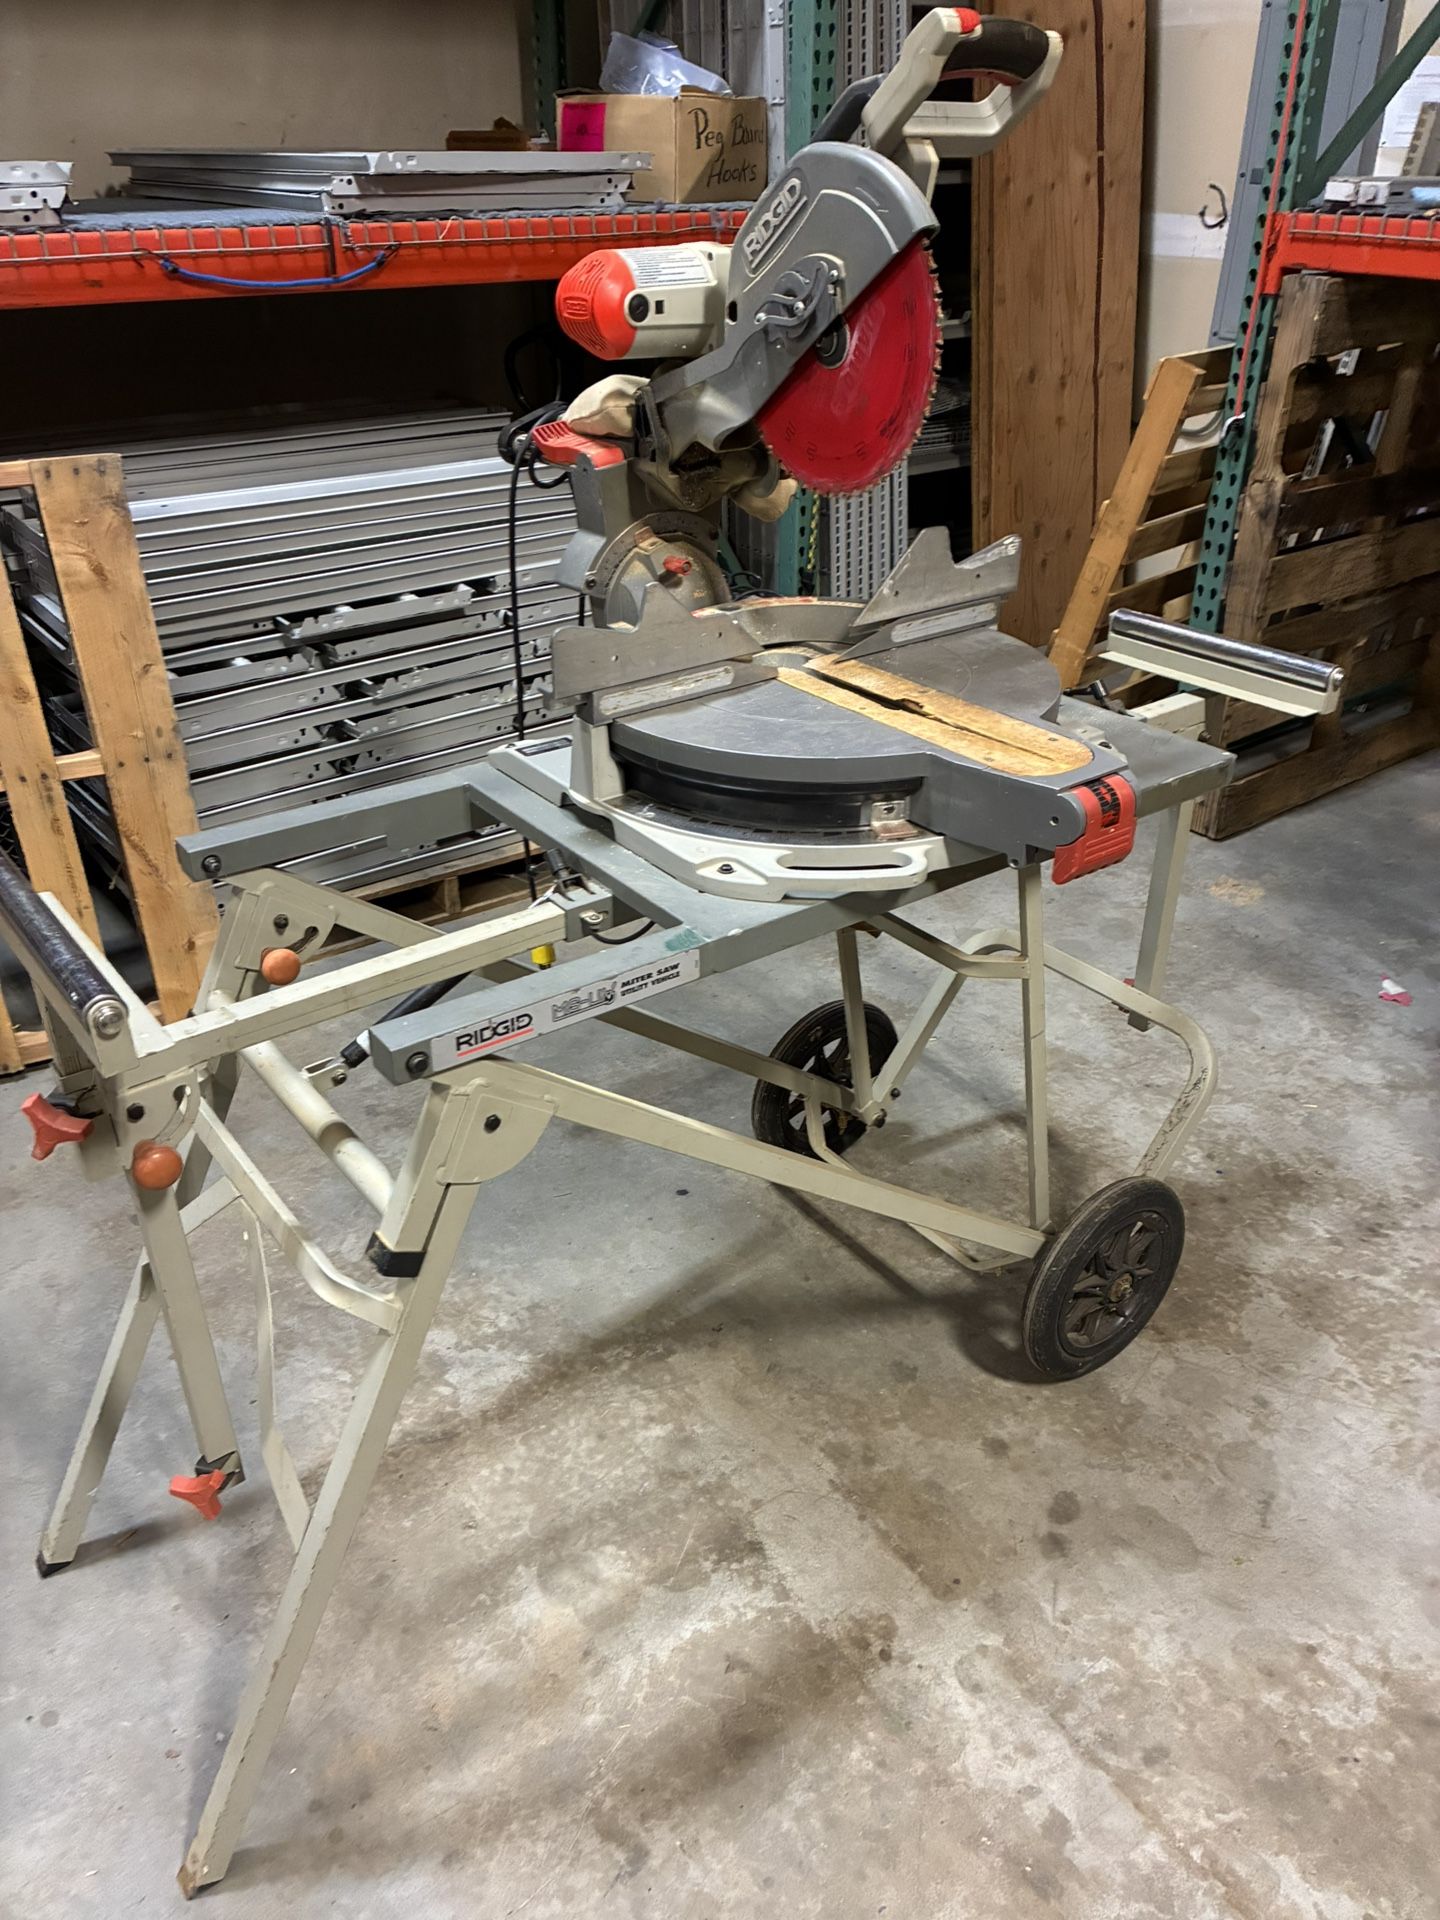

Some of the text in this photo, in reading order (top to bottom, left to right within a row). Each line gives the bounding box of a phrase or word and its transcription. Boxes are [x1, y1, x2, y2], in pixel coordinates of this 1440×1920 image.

[688, 107, 724, 162] Peg
[706, 158, 757, 188] Hooks
[743, 178, 801, 261] RIDGID
[620, 962, 680, 988] MITER SAW
[620, 971, 681, 997] UTILITY VEHICLE
[455, 1013, 533, 1051] RIDGID
